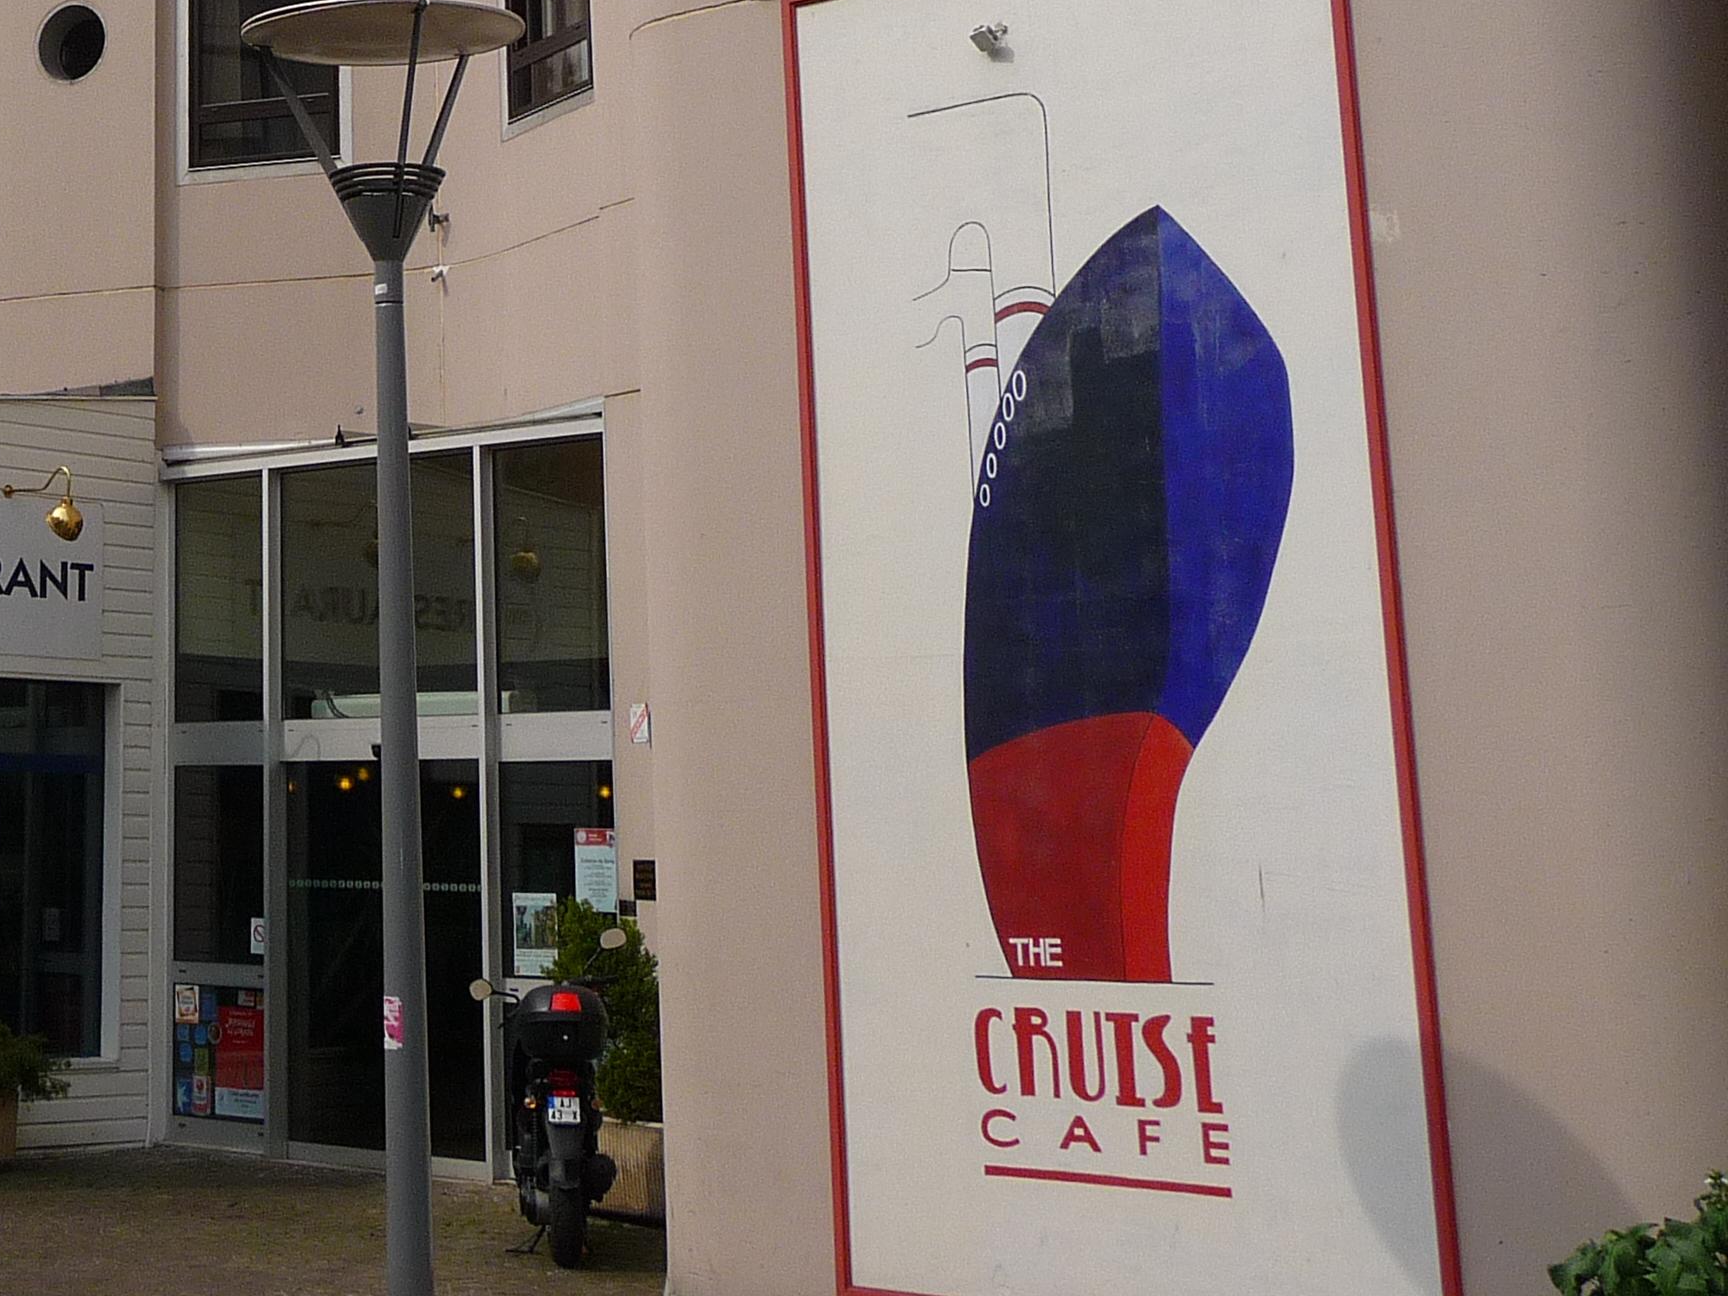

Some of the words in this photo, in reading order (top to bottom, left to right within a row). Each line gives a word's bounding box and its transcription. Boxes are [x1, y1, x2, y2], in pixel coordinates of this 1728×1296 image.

[1008, 936, 1063, 968] THE
[974, 1006, 1225, 1115] CRUISE
[980, 1108, 1231, 1166] CAFE
